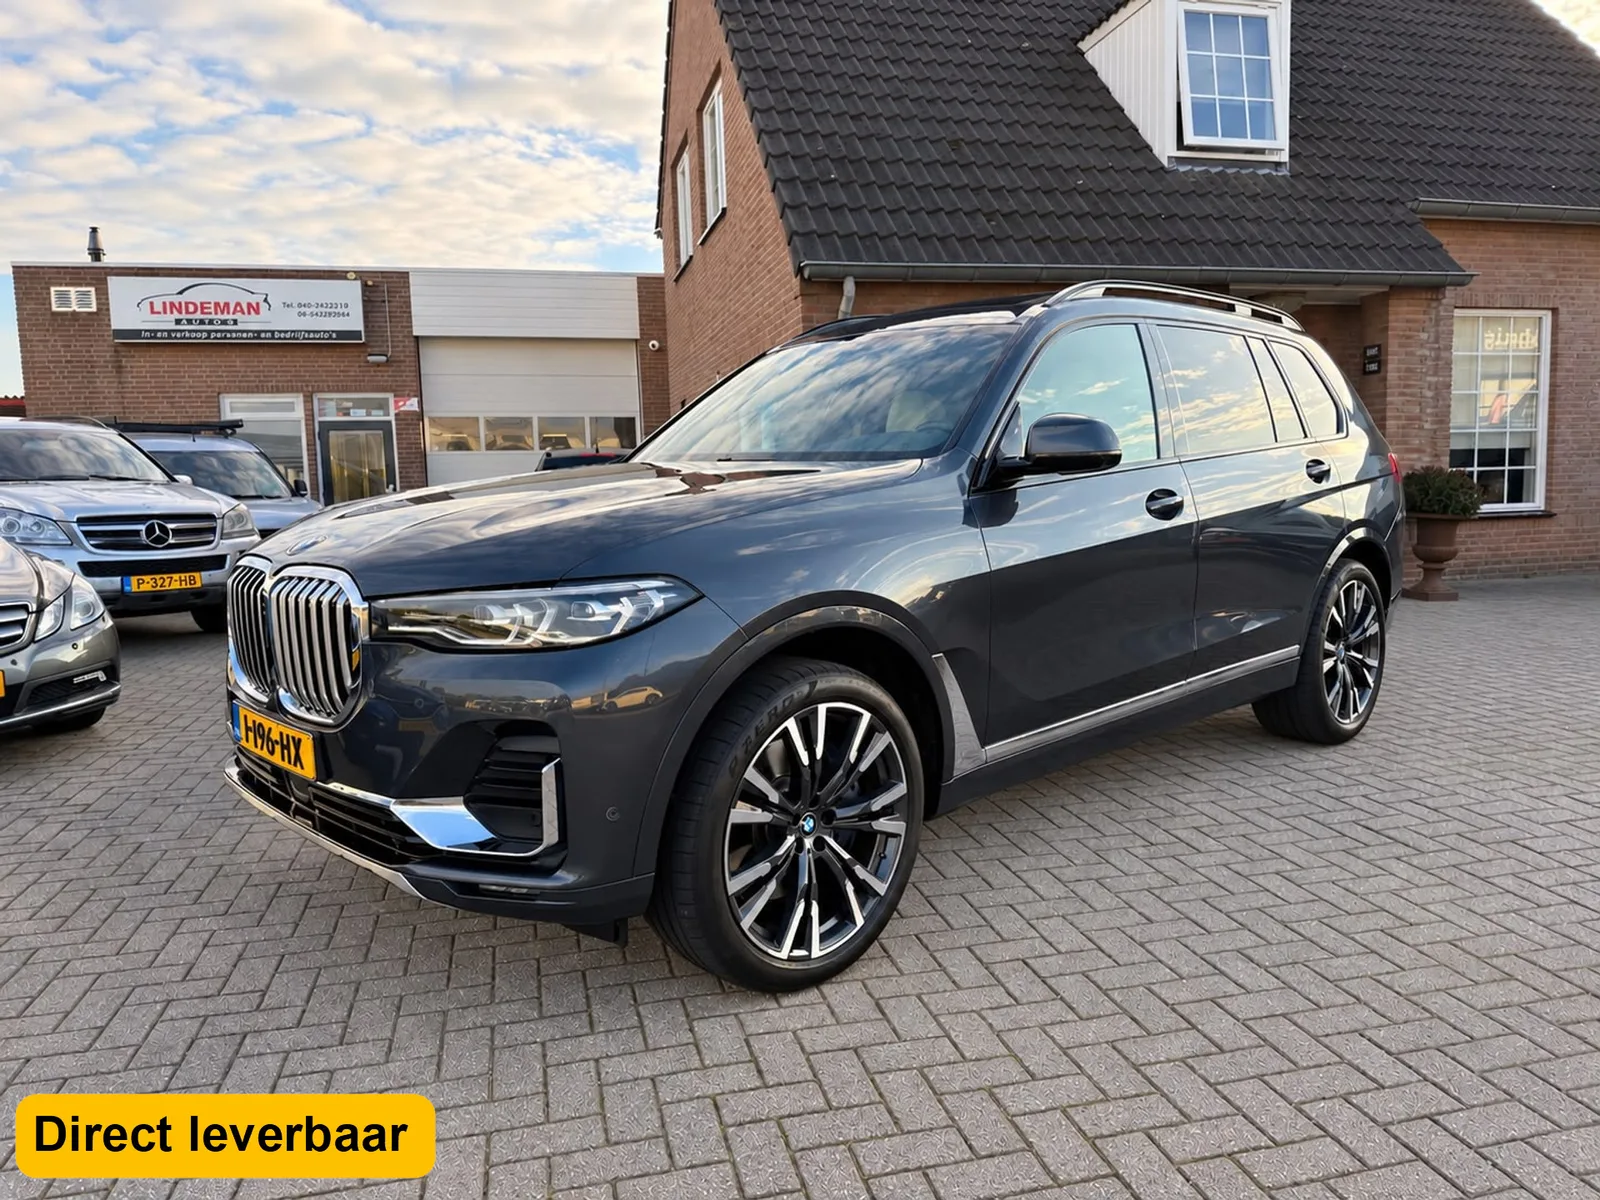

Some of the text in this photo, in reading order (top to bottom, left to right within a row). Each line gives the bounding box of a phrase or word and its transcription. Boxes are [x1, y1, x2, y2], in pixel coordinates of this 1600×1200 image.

[149, 300, 261, 316] LINDEMAN
[170, 330, 208, 340] verkoop
[136, 574, 197, 590] P-327-HB
